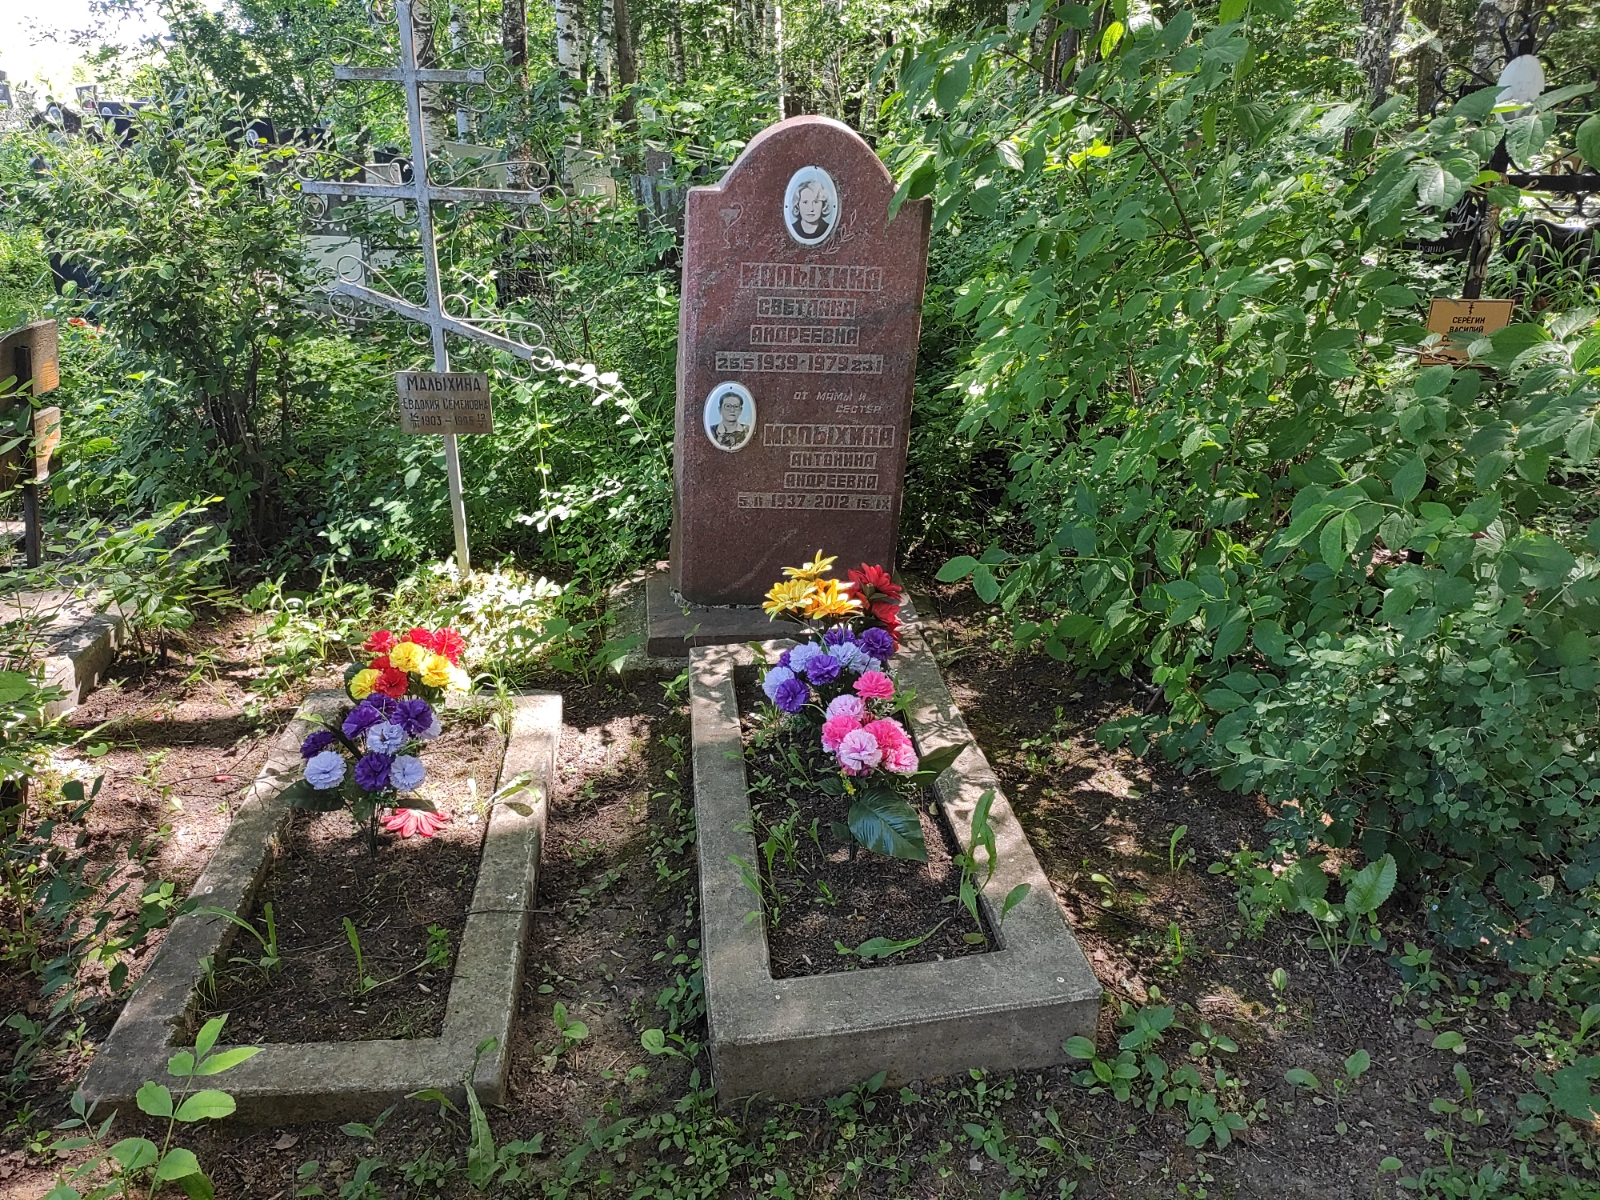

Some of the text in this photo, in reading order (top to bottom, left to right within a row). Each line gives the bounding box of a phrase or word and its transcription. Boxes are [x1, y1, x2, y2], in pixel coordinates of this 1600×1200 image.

[741, 263, 881, 290] МАЛЫХИНА
[758, 298, 855, 318] СВЕТЛАНА
[751, 325, 858, 346] АНДРЕЕВНА
[406, 375, 481, 392] МАЛЫХИНА
[402, 397, 440, 410] ЕВДОКИЯ
[421, 415, 442, 426] 1903
[764, 425, 894, 447] МАЛЫХИНА
[790, 452, 876, 469] АНТОНИНА
[785, 473, 878, 490] АНДРЕЕВНА
